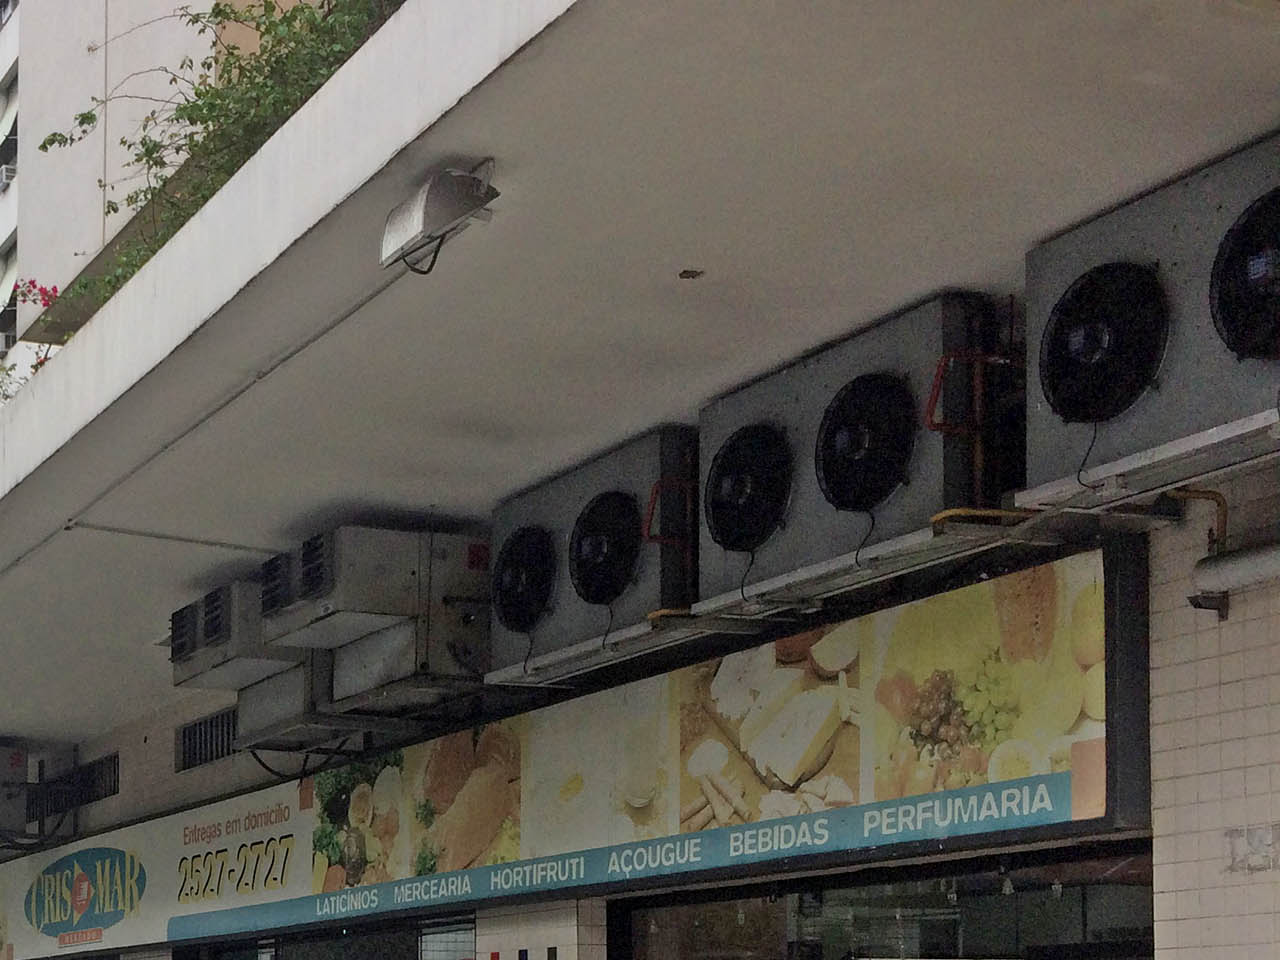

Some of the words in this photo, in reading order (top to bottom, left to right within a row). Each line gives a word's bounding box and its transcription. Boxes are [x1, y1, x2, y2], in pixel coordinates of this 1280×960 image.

[178, 834, 297, 904] 2527-2727
[183, 821, 222, 846] Entregas
[225, 818, 241, 836] em
[315, 888, 379, 915] LATICÍNIOS
[393, 874, 472, 905] MERCEARIA
[490, 856, 585, 890] HORTIFRUTI
[607, 837, 702, 879] AÇOUGUE
[729, 818, 829, 858] BEBIDAS
[862, 782, 1053, 839] PERFUMARIA
[31, 868, 72, 935] CRIS
[94, 848, 141, 917] MAR
